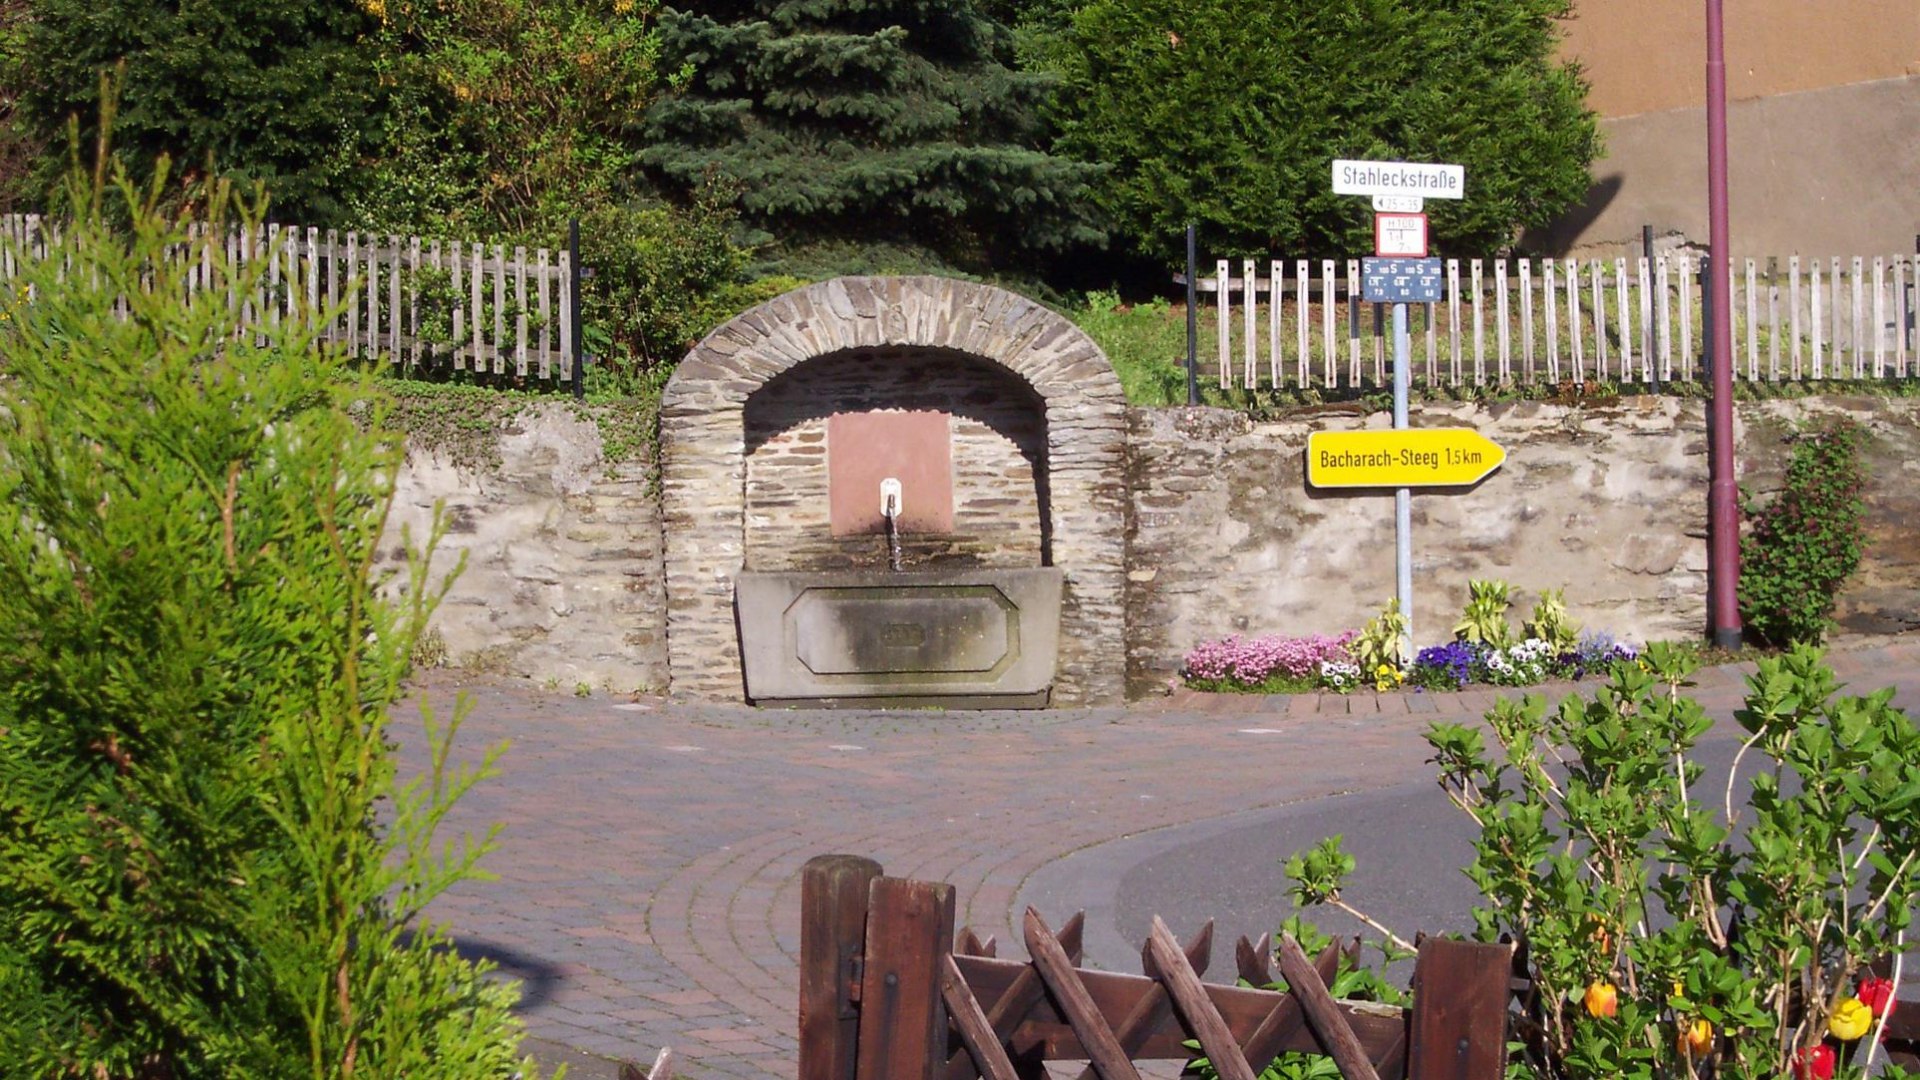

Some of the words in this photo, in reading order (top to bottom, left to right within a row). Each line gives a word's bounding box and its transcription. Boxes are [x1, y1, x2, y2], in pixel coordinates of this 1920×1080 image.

[1343, 166, 1457, 189] Stahleckstraße
[1364, 263, 1372, 274] S
[1390, 263, 1397, 274] S
[1416, 264, 1424, 275] S
[1320, 448, 1439, 470] Bacharach-Steeg
[1462, 448, 1482, 465] km
